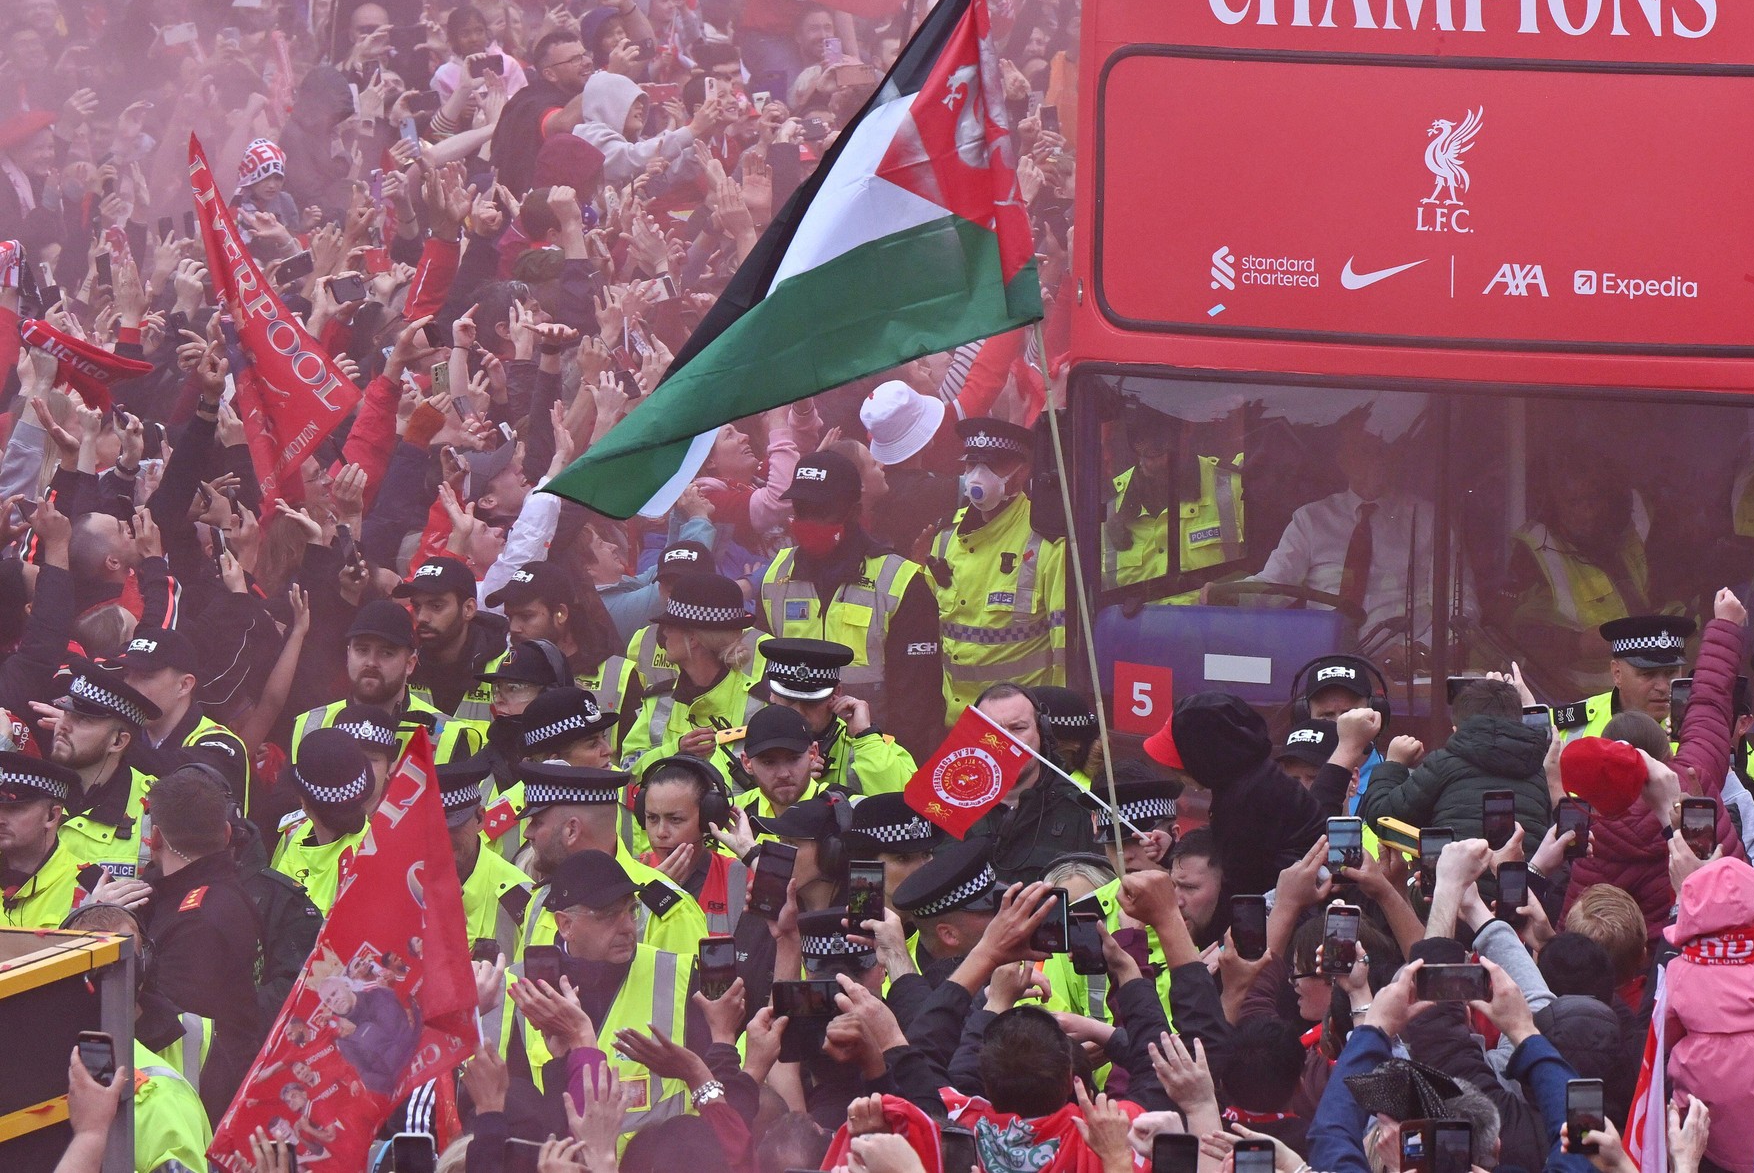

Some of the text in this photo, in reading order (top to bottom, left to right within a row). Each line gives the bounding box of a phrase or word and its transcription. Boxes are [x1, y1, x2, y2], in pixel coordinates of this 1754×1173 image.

[1415, 208, 1475, 234] L.F.C.
[1241, 254, 1316, 273] standard
[1241, 270, 1320, 290] chartered
[1482, 263, 1549, 297] AXA
[1602, 272, 1698, 299] Expedia
[797, 468, 827, 480] FGH
[1190, 529, 1220, 543] POLICE
[664, 549, 698, 561] FGH
[908, 643, 938, 653] FGH
[1317, 666, 1356, 679] FGH
[1131, 682, 1154, 717] 5
[1287, 729, 1325, 742] FGH
